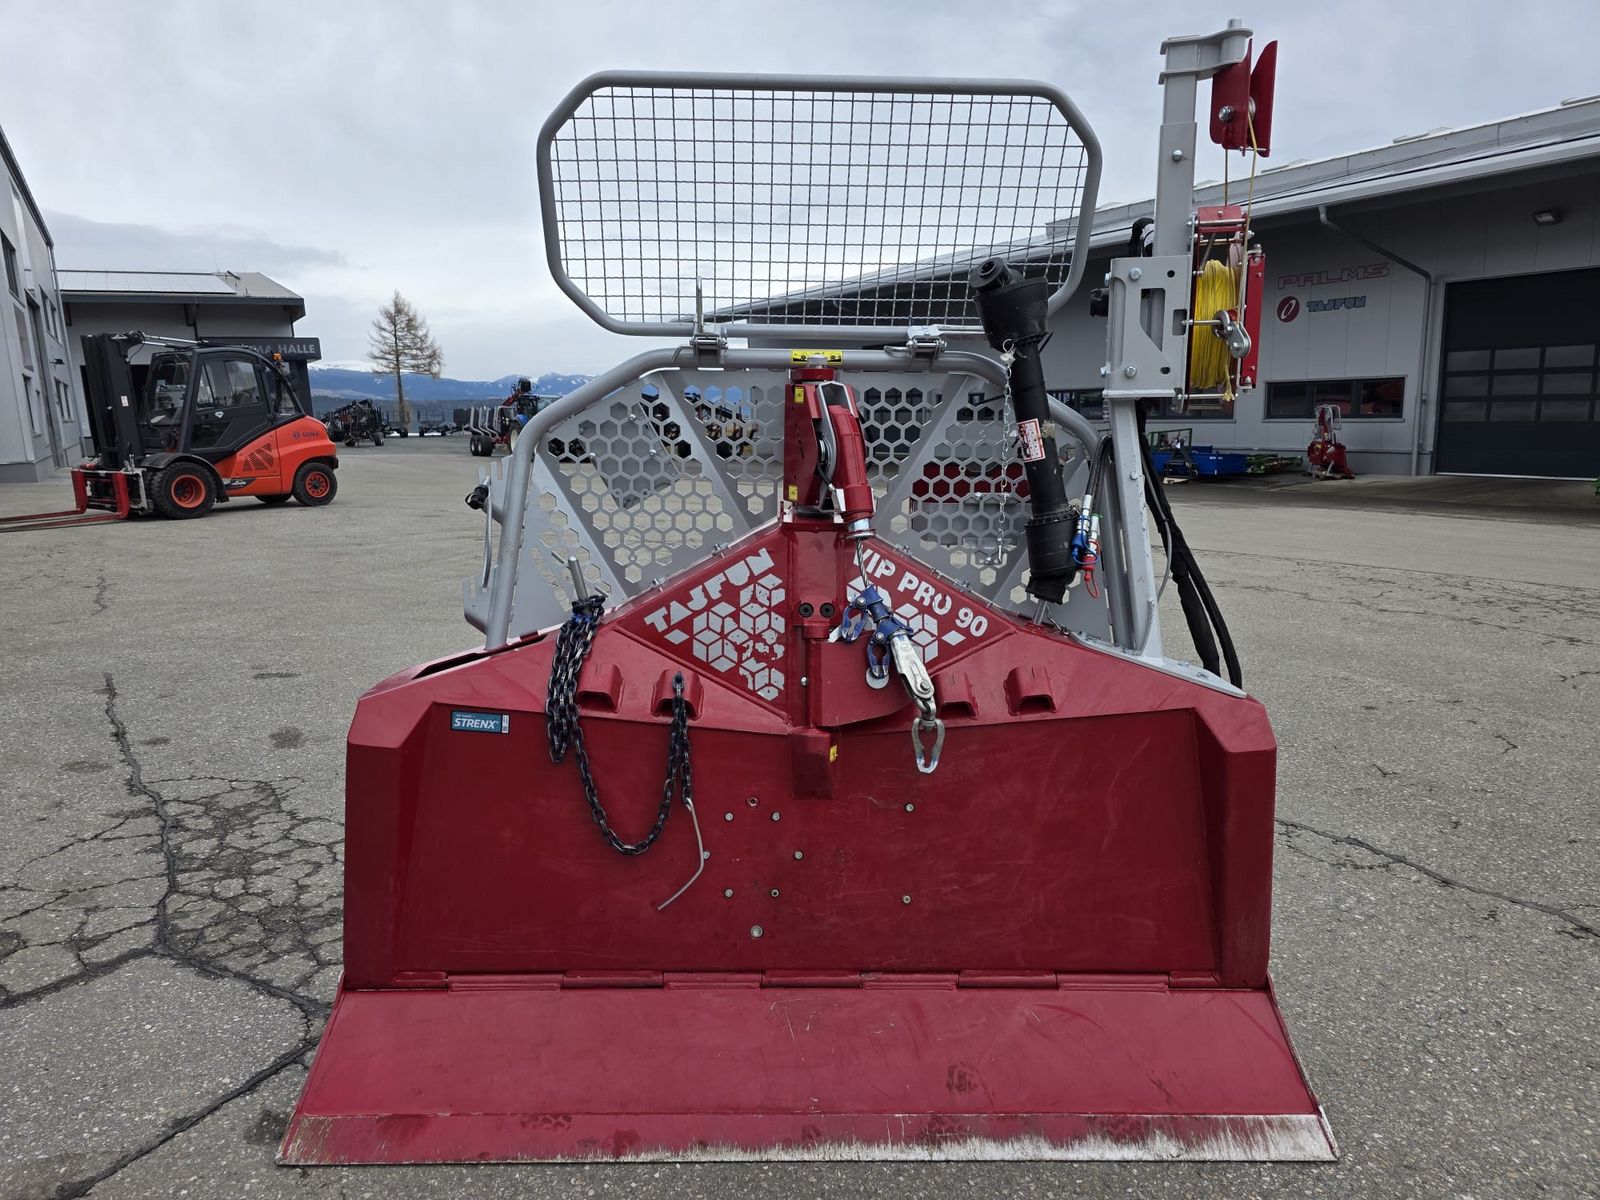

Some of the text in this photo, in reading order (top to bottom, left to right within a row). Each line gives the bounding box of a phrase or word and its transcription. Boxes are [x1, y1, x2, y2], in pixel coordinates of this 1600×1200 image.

[1278, 263, 1390, 290] PALMS
[1306, 296, 1366, 312] TAJFUN
[278, 344, 316, 354] HALLE
[644, 547, 775, 633] TAJFUN
[897, 571, 953, 616] PRO
[955, 607, 989, 637] 90
[453, 717, 497, 730] STRENX
